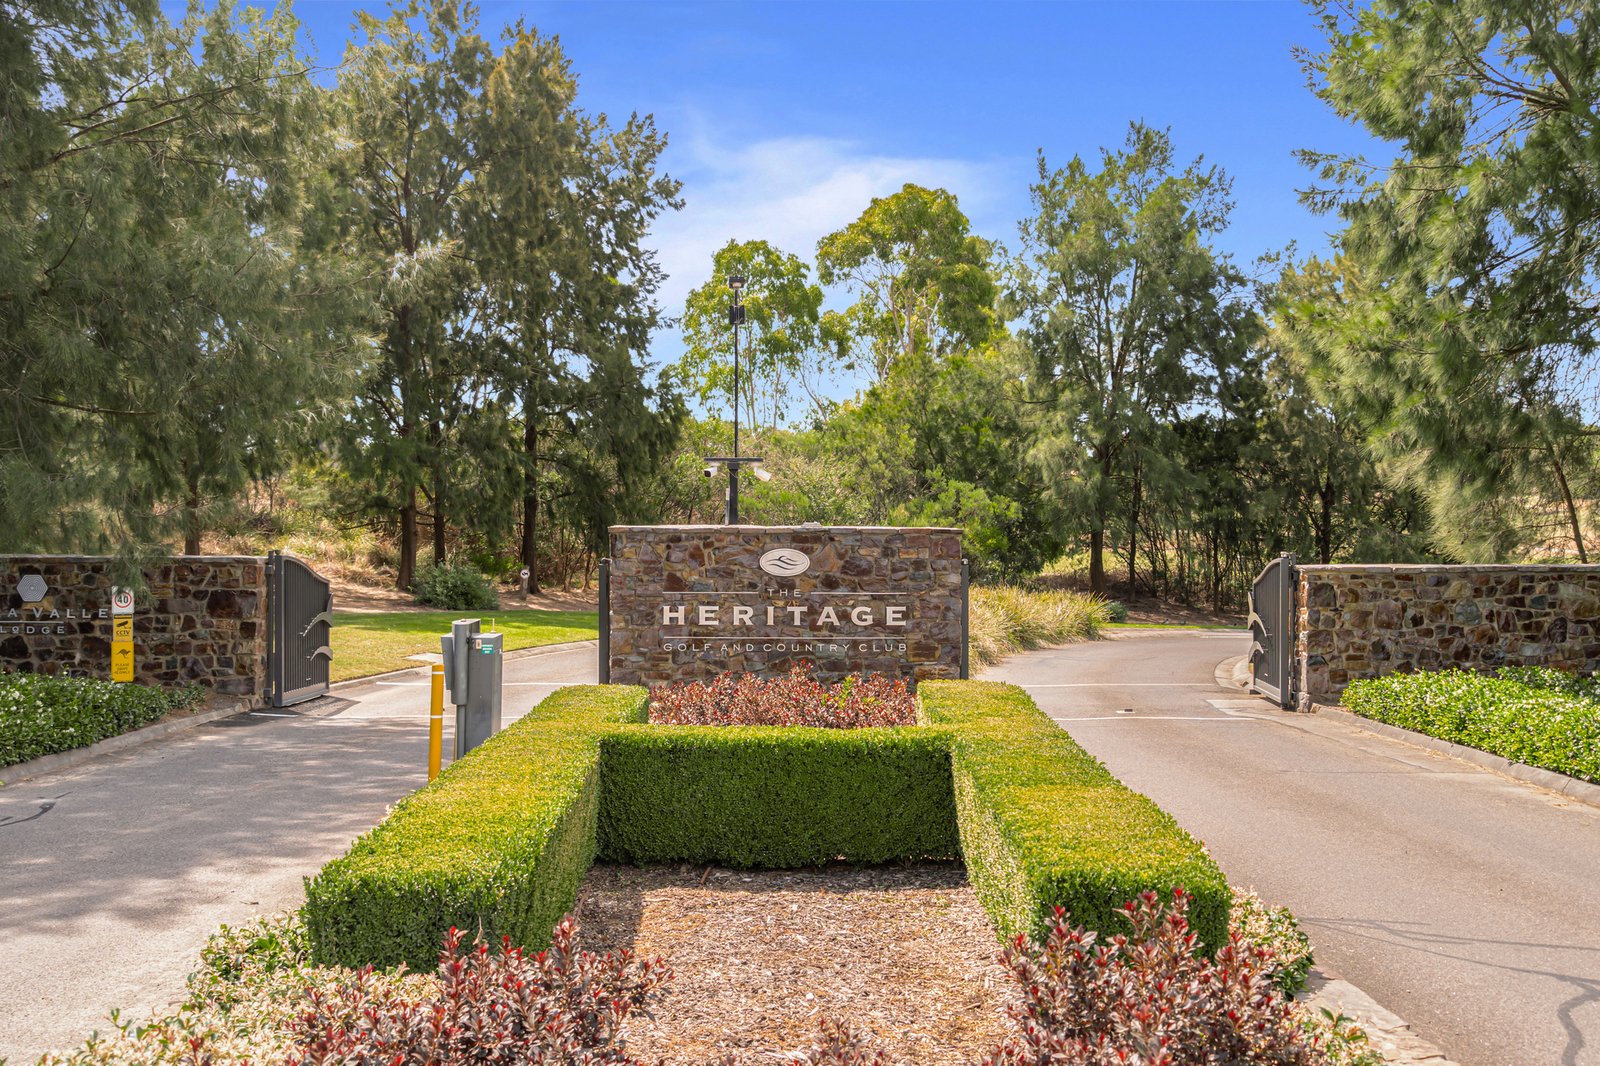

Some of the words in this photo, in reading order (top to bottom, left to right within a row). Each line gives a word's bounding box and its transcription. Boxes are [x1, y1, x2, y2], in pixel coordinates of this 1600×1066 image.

[767, 588, 802, 597] THE
[117, 595, 129, 604] 40
[32, 607, 108, 618] VALLE
[662, 605, 907, 626] HERITAGE
[0, 626, 65, 634] LODGE
[663, 643, 712, 652] GOLF
[720, 643, 754, 652] AND
[763, 643, 850, 652] COUNTRY
[859, 643, 907, 652] CLUB
